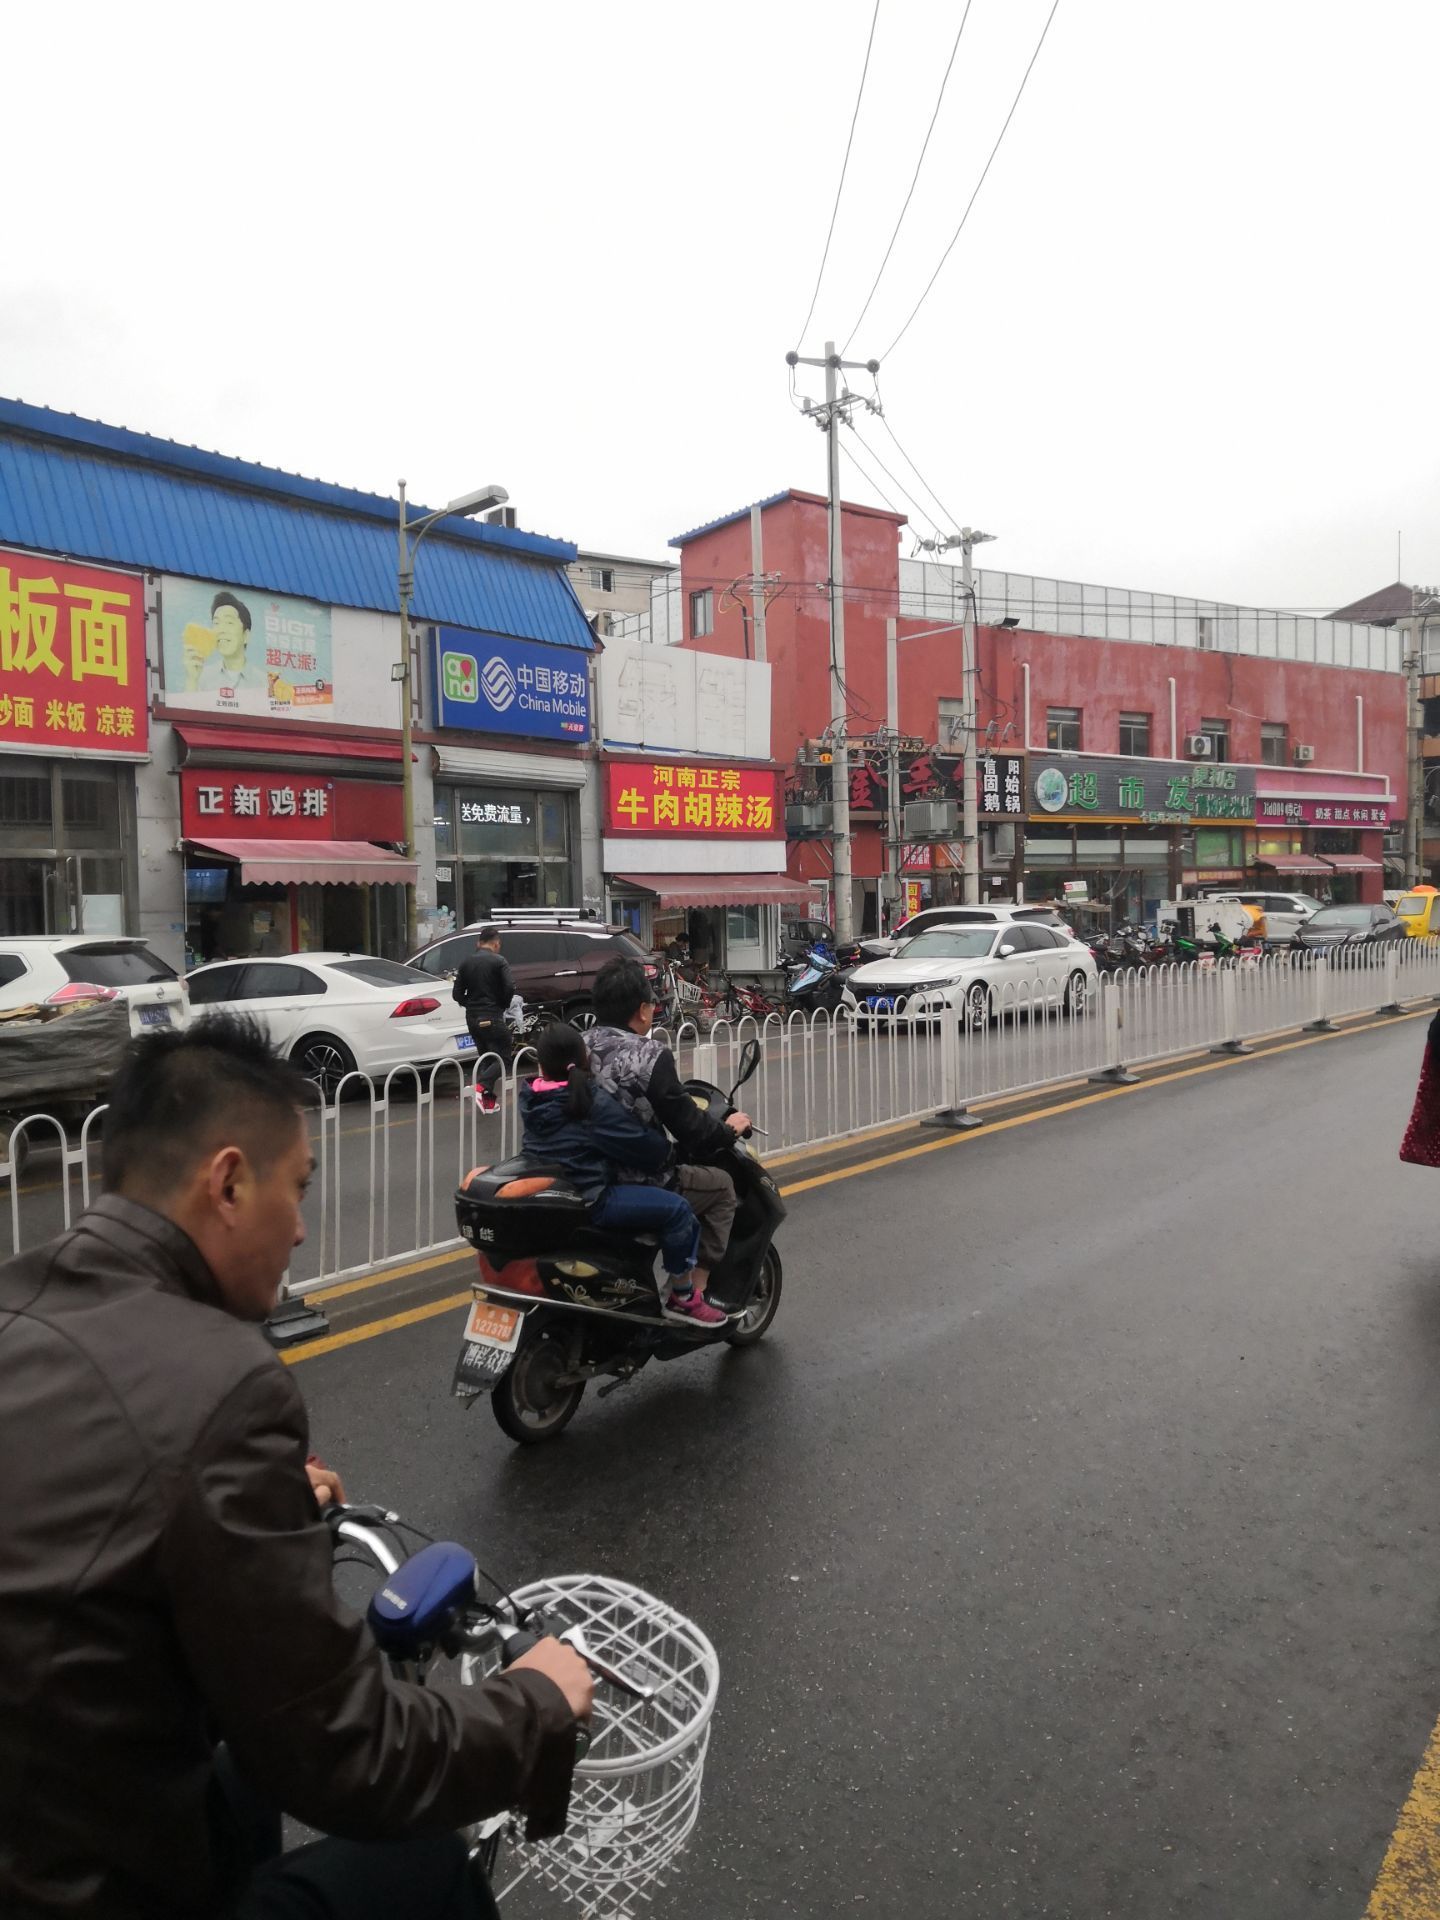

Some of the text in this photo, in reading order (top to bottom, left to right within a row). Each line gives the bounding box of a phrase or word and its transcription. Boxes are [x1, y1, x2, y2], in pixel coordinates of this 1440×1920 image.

[0, 567, 130, 686] 板面
[517, 664, 585, 698] 中国移动
[46, 699, 86, 732] 米饭
[96, 704, 135, 737] 凉菜
[518, 693, 586, 717] China Mobile
[652, 765, 740, 791] 河南正宗
[198, 784, 328, 817] 正新鸡排
[617, 788, 772, 829] 牛肉胡辣汤
[1315, 807, 1332, 820] 奶茶
[1334, 808, 1350, 820] 甜点
[1352, 808, 1368, 821] 休闲
[1371, 808, 1387, 821] 聚会
